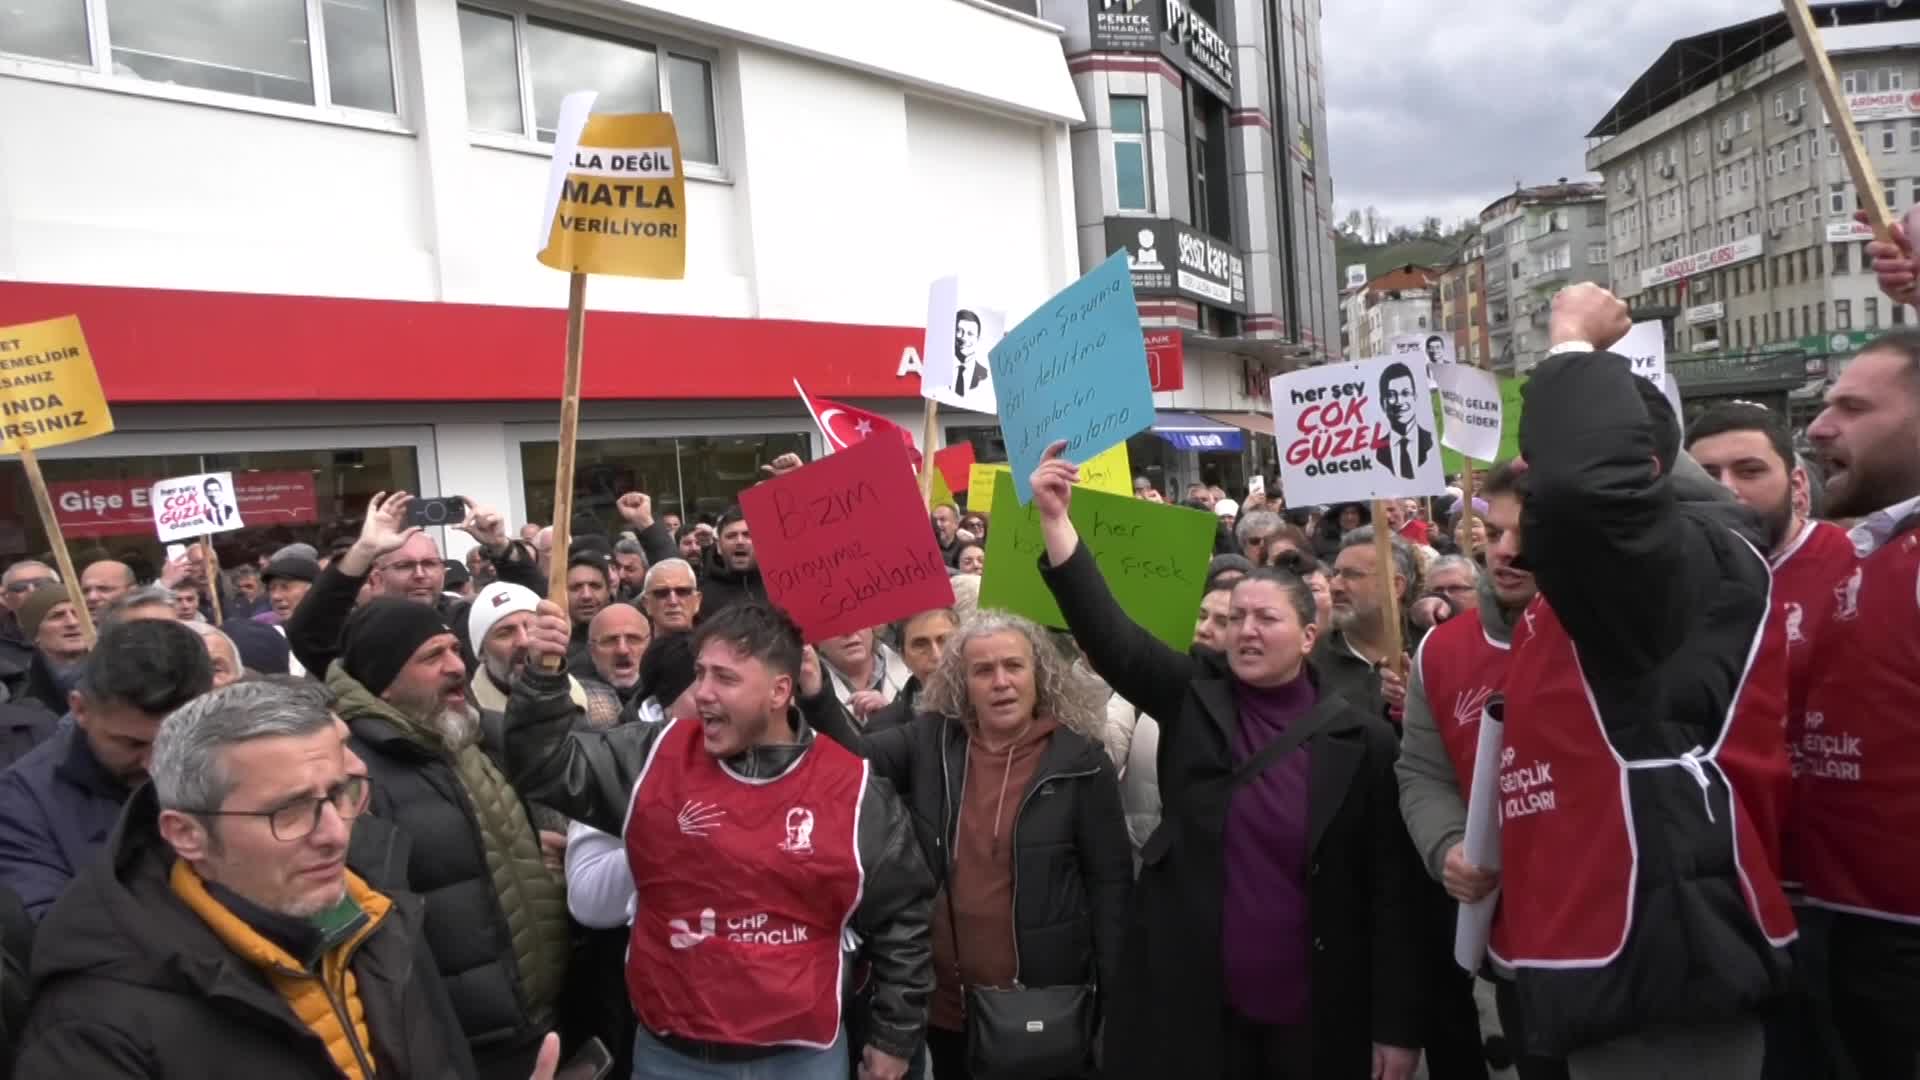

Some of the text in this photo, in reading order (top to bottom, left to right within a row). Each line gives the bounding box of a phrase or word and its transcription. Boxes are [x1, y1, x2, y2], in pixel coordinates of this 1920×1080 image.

[1097, 13, 1150, 24] PERTEK
[1190, 14, 1232, 70] PERTEK
[569, 152, 671, 172] LA DEĞİL
[560, 216, 678, 238] VERİLİYOR!
[1633, 356, 1656, 368] YE
[1290, 386, 1327, 405] her
[1465, 397, 1499, 412] GELEN
[1286, 422, 1391, 466] GÜZEL
[1305, 456, 1373, 477] olacak
[59, 488, 150, 515] Gişe E
[1806, 711, 1825, 729] HP
[727, 913, 769, 929] CHP
